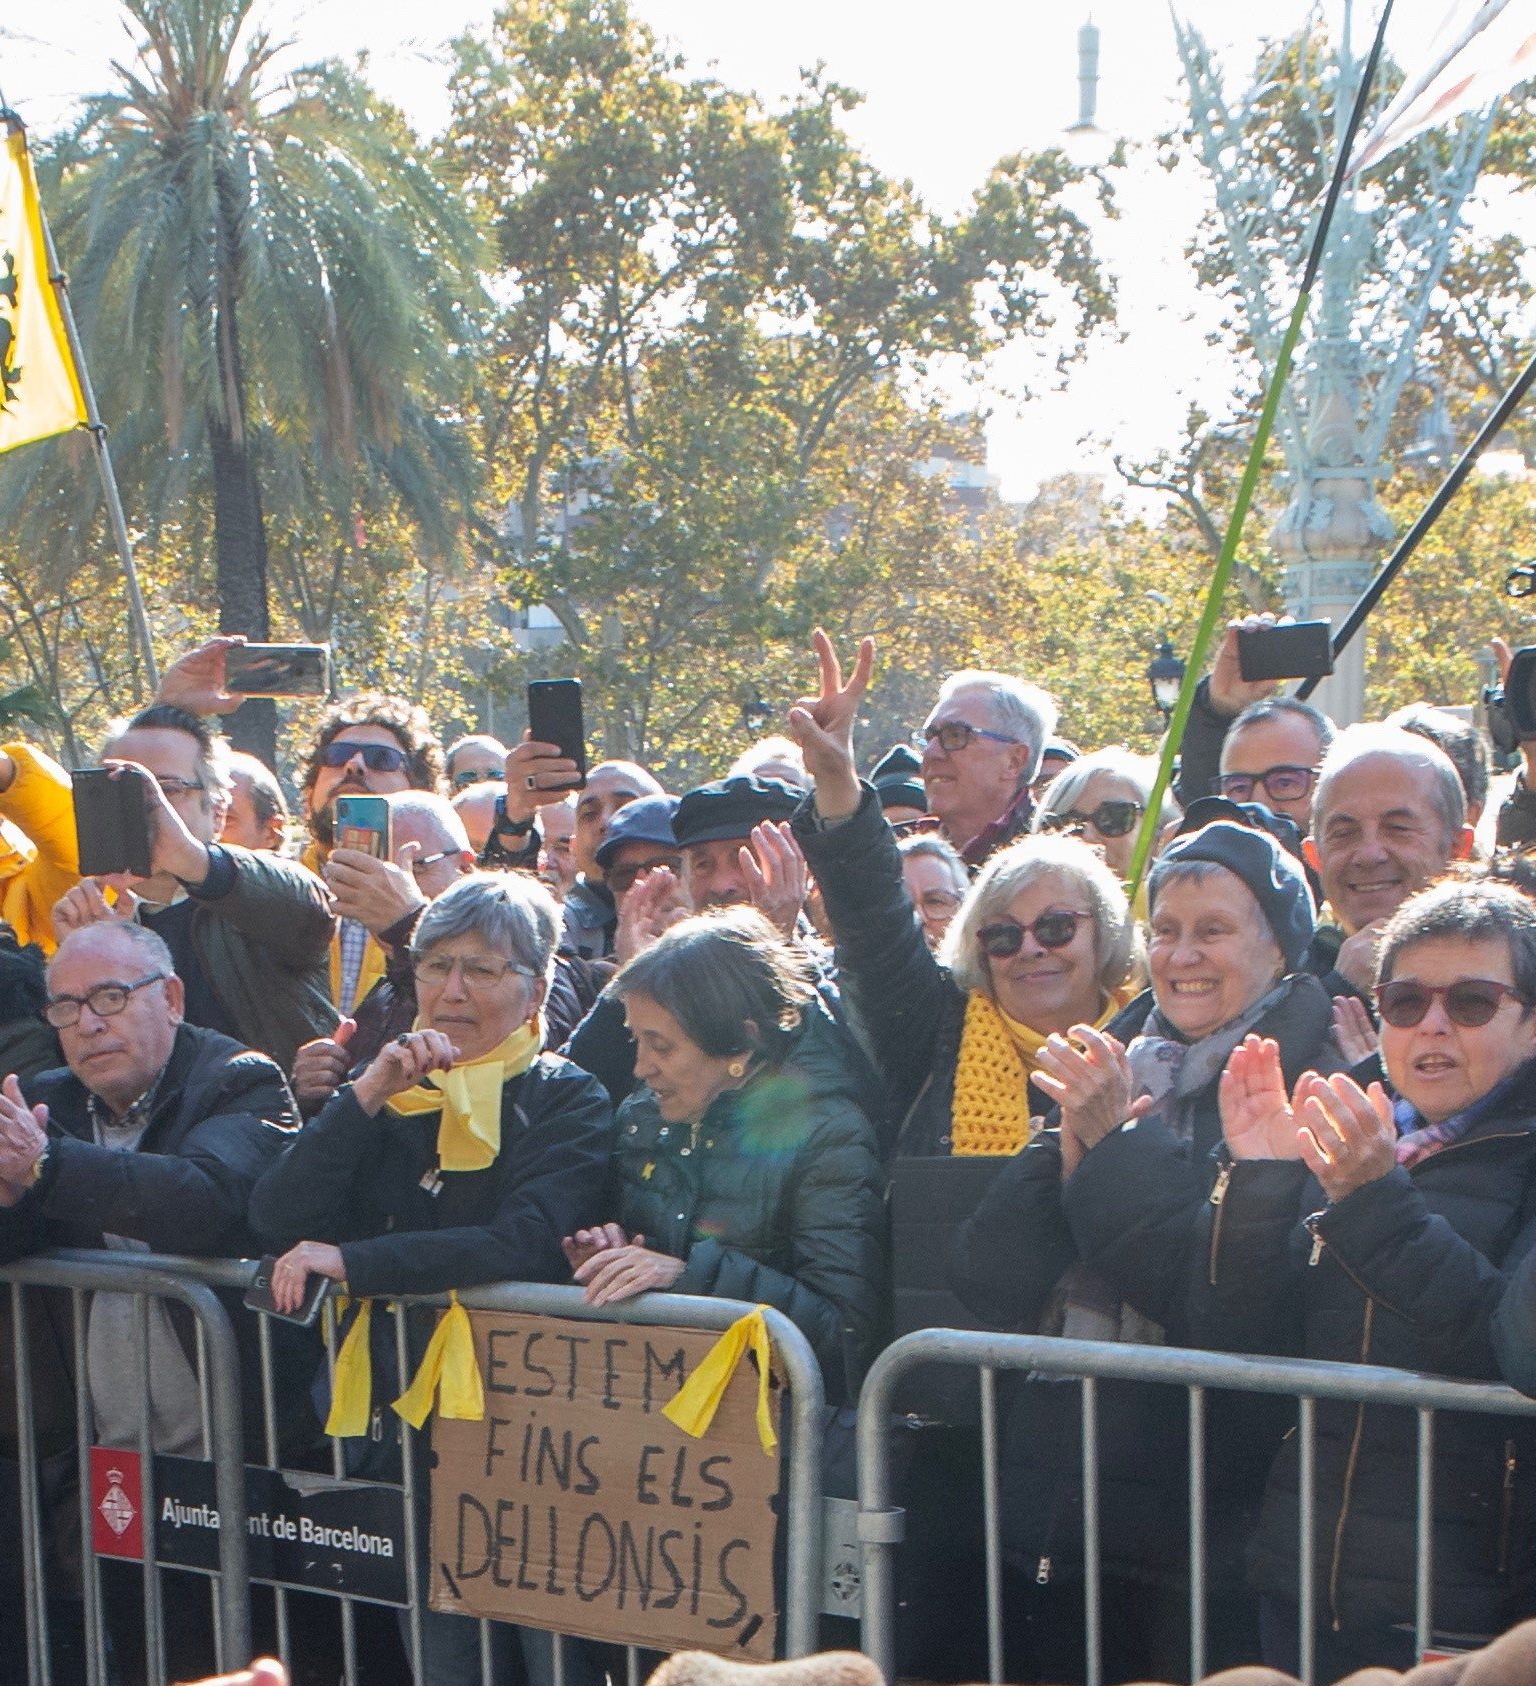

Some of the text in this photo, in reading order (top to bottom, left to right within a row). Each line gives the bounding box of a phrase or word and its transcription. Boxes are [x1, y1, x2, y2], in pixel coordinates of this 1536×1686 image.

[486, 1329, 686, 1414] ESTEM
[637, 1445, 733, 1511] ELS
[162, 1497, 394, 1558] Ajuntant de Barcelona
